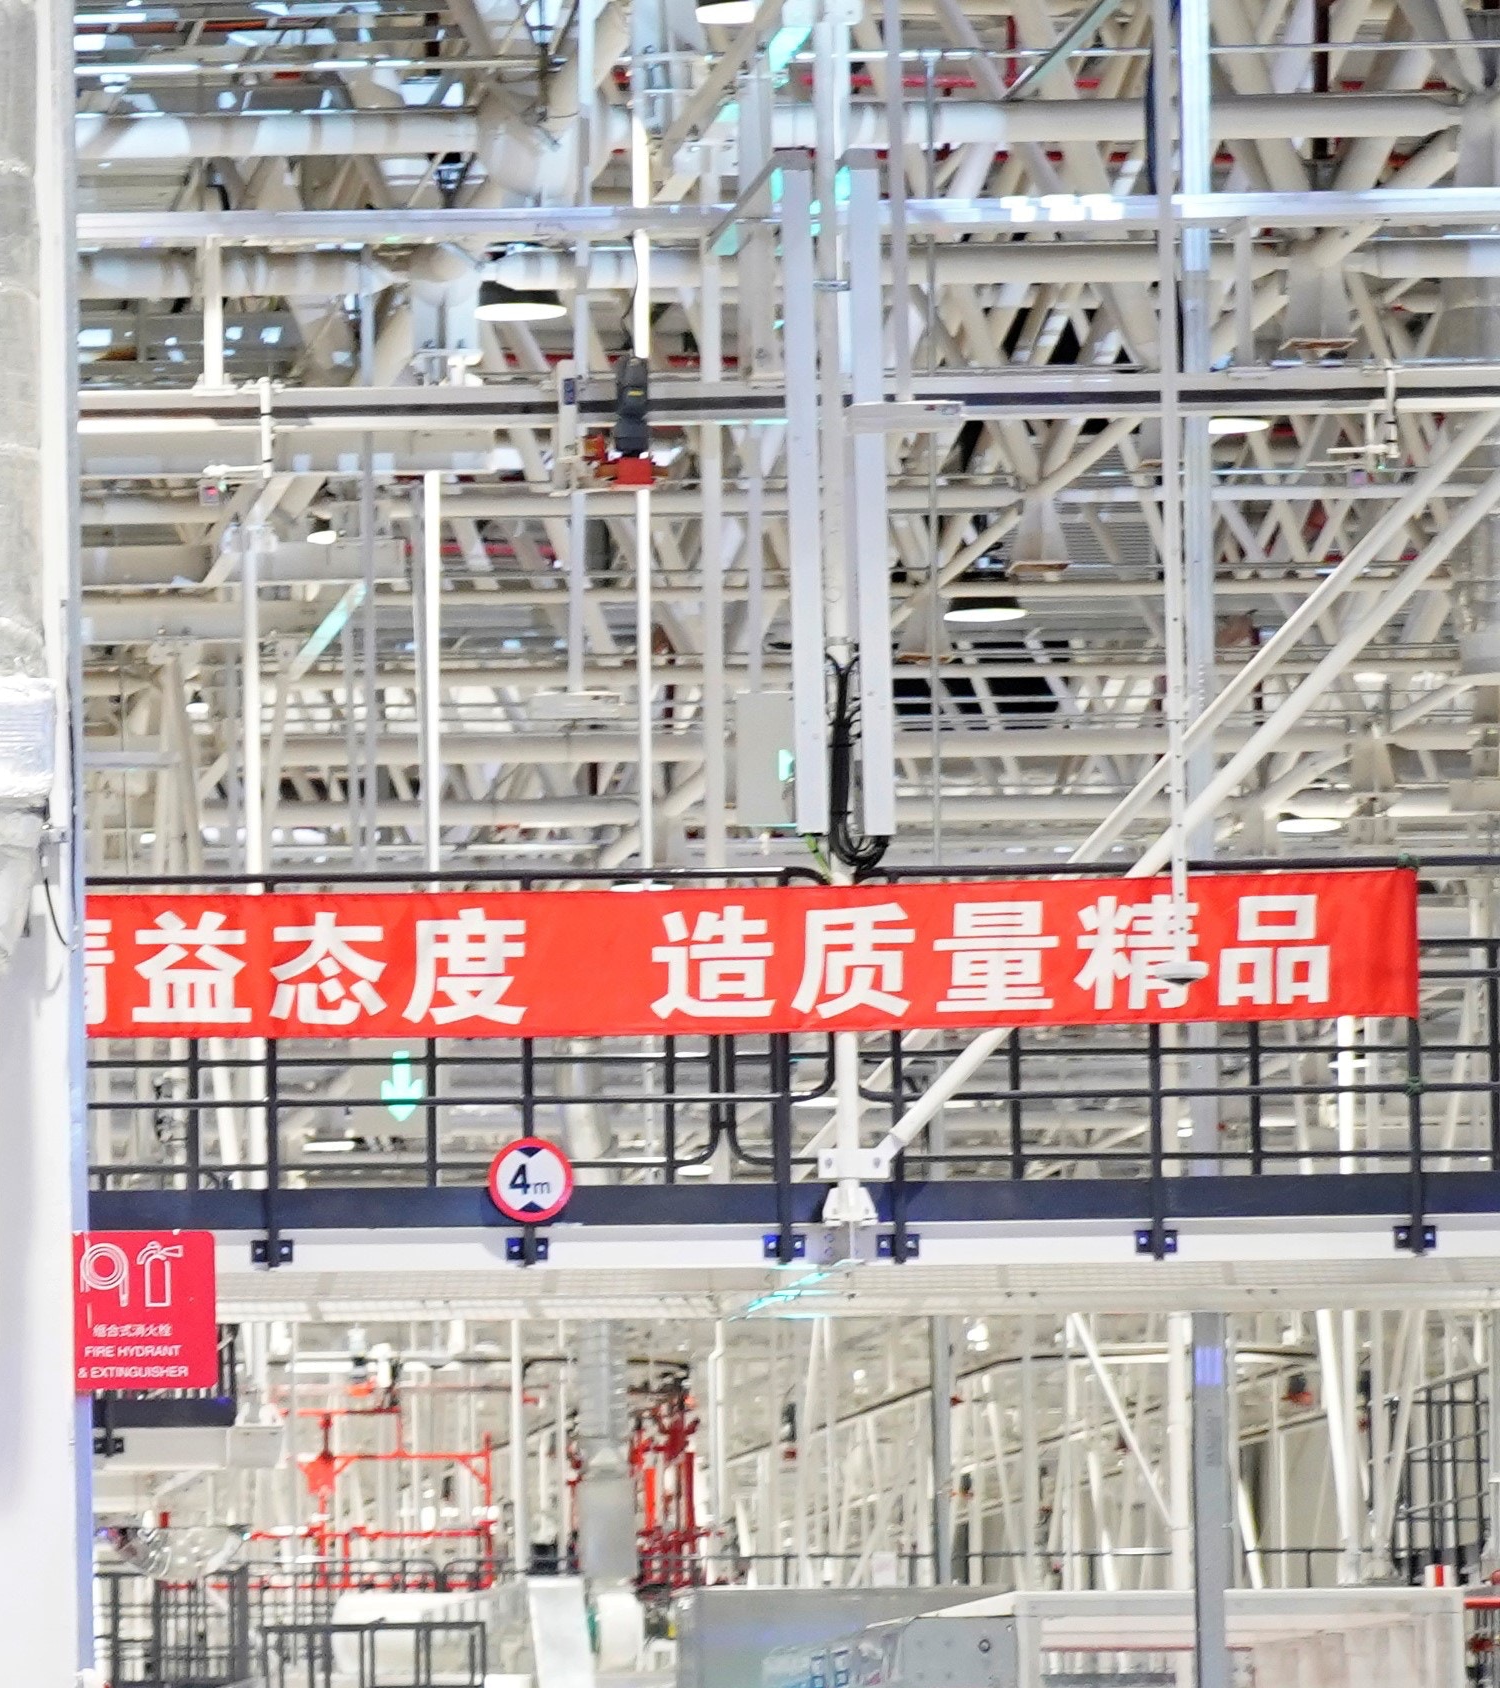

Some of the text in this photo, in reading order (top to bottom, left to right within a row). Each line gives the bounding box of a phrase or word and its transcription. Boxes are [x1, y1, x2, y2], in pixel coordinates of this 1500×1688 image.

[649, 894, 1336, 1019] 造质量精品
[84, 1344, 181, 1357] FIRE HYDRANT
[90, 1365, 188, 1378] EXTINGUISHER
